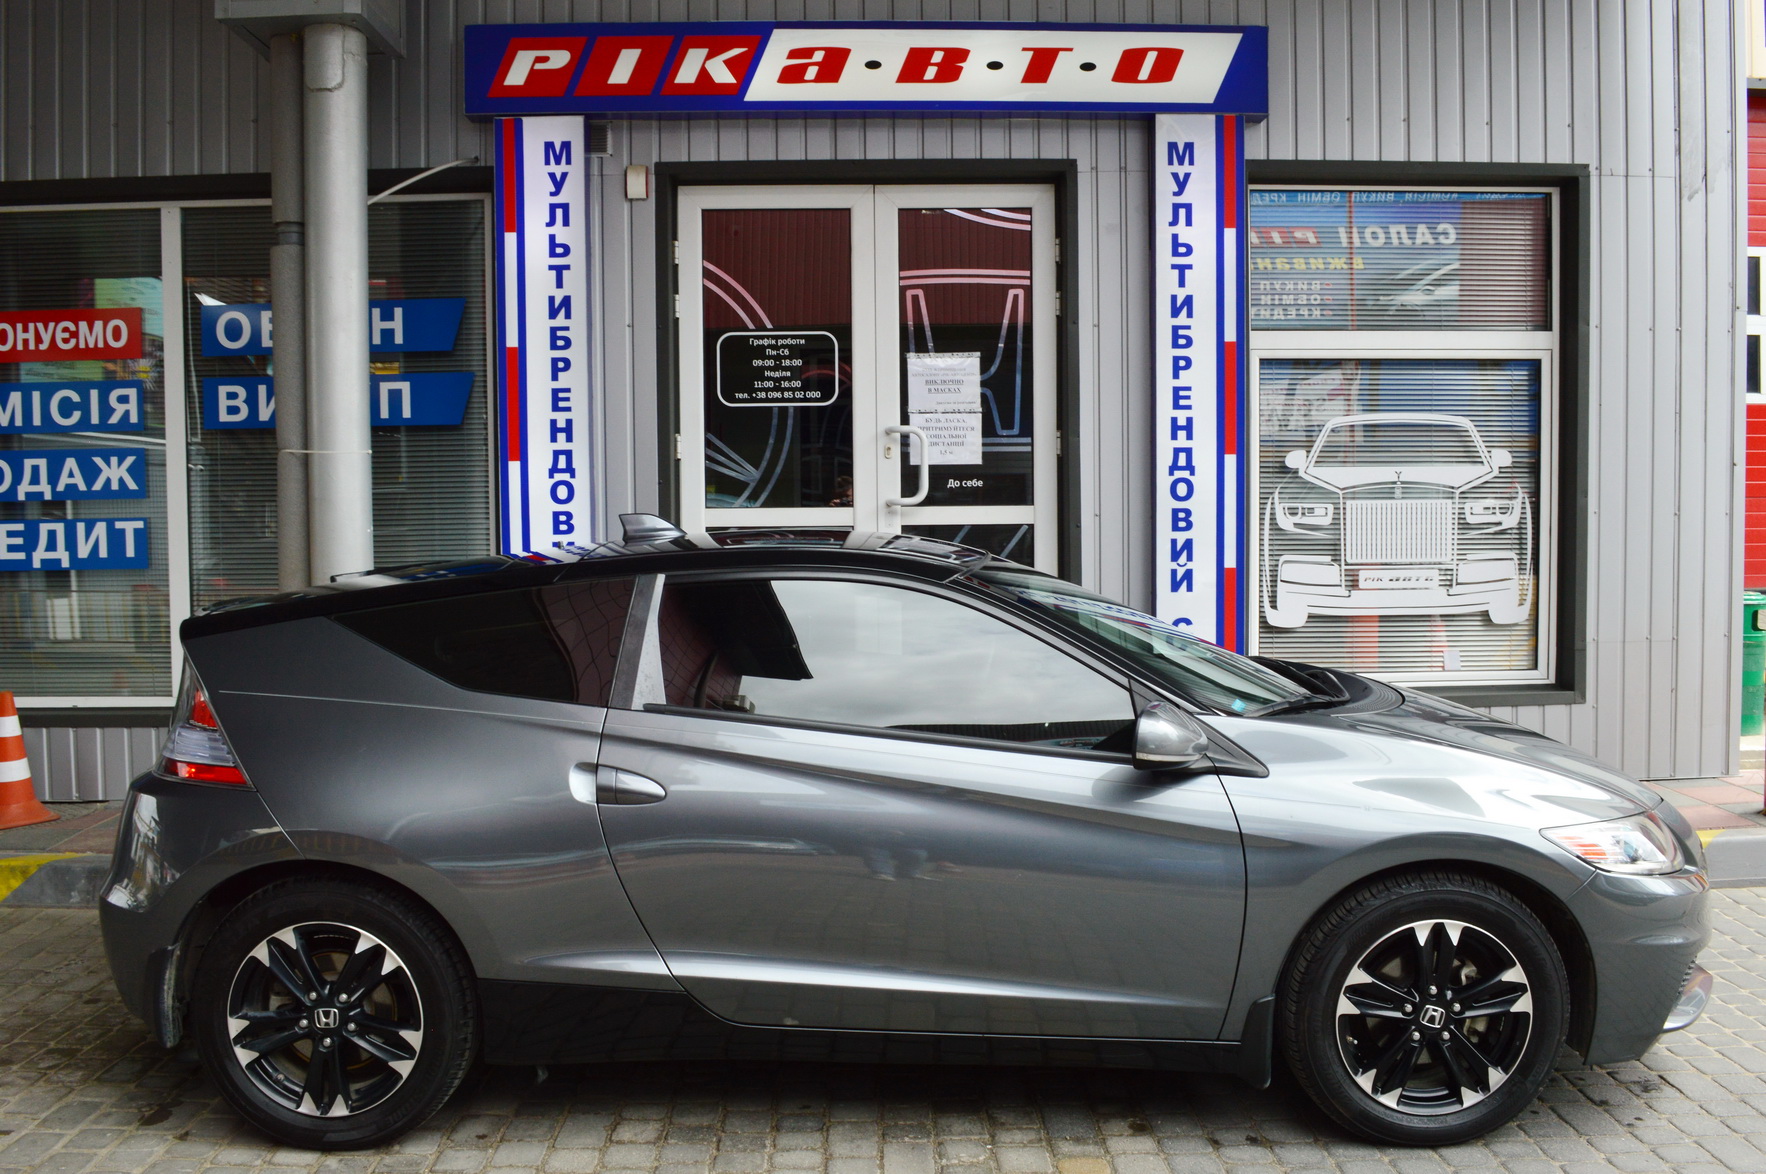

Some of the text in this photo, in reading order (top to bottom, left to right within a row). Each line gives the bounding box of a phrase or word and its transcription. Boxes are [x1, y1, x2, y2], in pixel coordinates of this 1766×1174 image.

[543, 140, 576, 548] МУЛЬТИБРЕНДОВ
[749, 338, 806, 346] Графік роботи
[765, 348, 790, 356] Пн-Сб
[752, 359, 775, 367] 09:00
[781, 359, 803, 367] 18:00
[1167, 141, 1196, 592] МУЛЬТИБРЕНДОВИЙ
[764, 369, 791, 378] Неділя
[753, 380, 774, 388] 11:00
[780, 380, 802, 388] 16:00
[734, 391, 751, 399] тел.
[752, 391, 767, 399] +38
[767, 391, 782, 399] 096
[947, 478, 984, 489] До себе
